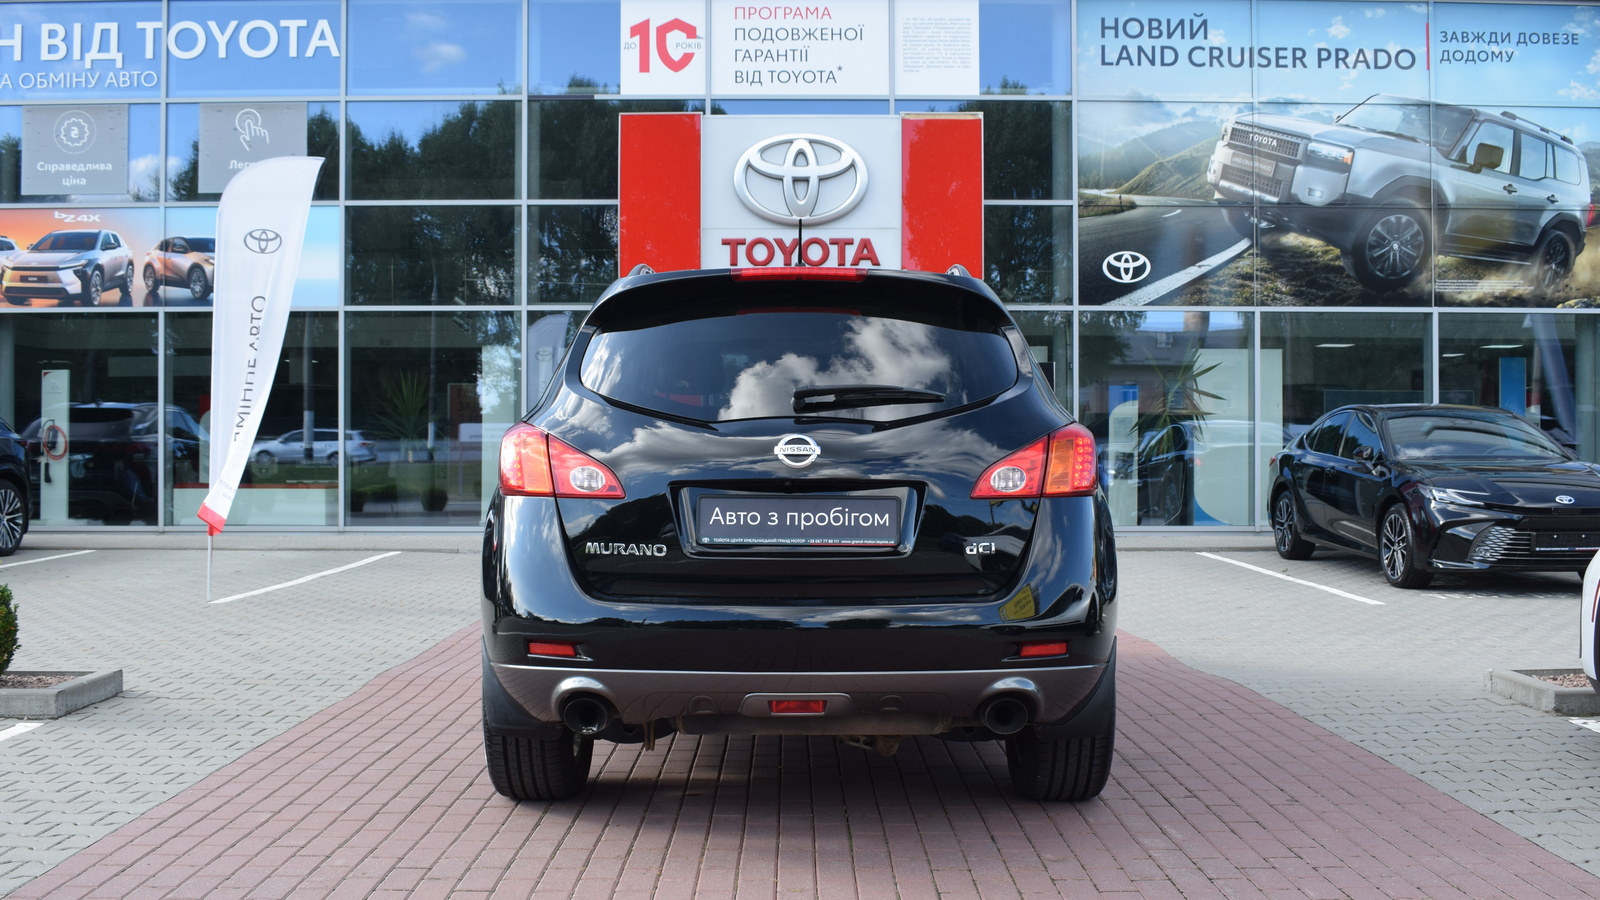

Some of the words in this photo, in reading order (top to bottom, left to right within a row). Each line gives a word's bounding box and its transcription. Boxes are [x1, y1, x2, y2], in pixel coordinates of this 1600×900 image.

[733, 6, 832, 20] ПРОГРАМА
[733, 24, 865, 44] ПОДОВЖЕНОЇ
[1100, 13, 1209, 41] НОВИЙ
[40, 22, 123, 69] ВІД
[136, 19, 340, 60] TOYOTA
[623, 42, 637, 51] ДО
[675, 42, 702, 50] РОКІВ
[1440, 30, 1512, 47] ЗАВЖДИ
[1516, 31, 1580, 47] ДОВЕЗЕ
[733, 45, 809, 63] ГАРАНТІЇ
[1100, 45, 1179, 68] LAND
[1187, 46, 1307, 69] CRUISER
[1317, 48, 1417, 71] PRADO
[1440, 48, 1515, 65] ДОДОМУ
[19, 71, 101, 89] ОБМІНУ
[105, 70, 158, 88] АВТО
[733, 70, 764, 86] ВІД
[1249, 133, 1277, 147] TOYOTA
[37, 161, 113, 174] Справедлива
[62, 175, 87, 187] ціна
[721, 237, 881, 267] TOYOTA
[709, 506, 761, 526] Авто
[766, 511, 779, 527] з
[786, 507, 889, 530] пробігом
[584, 541, 667, 557] MURANO
